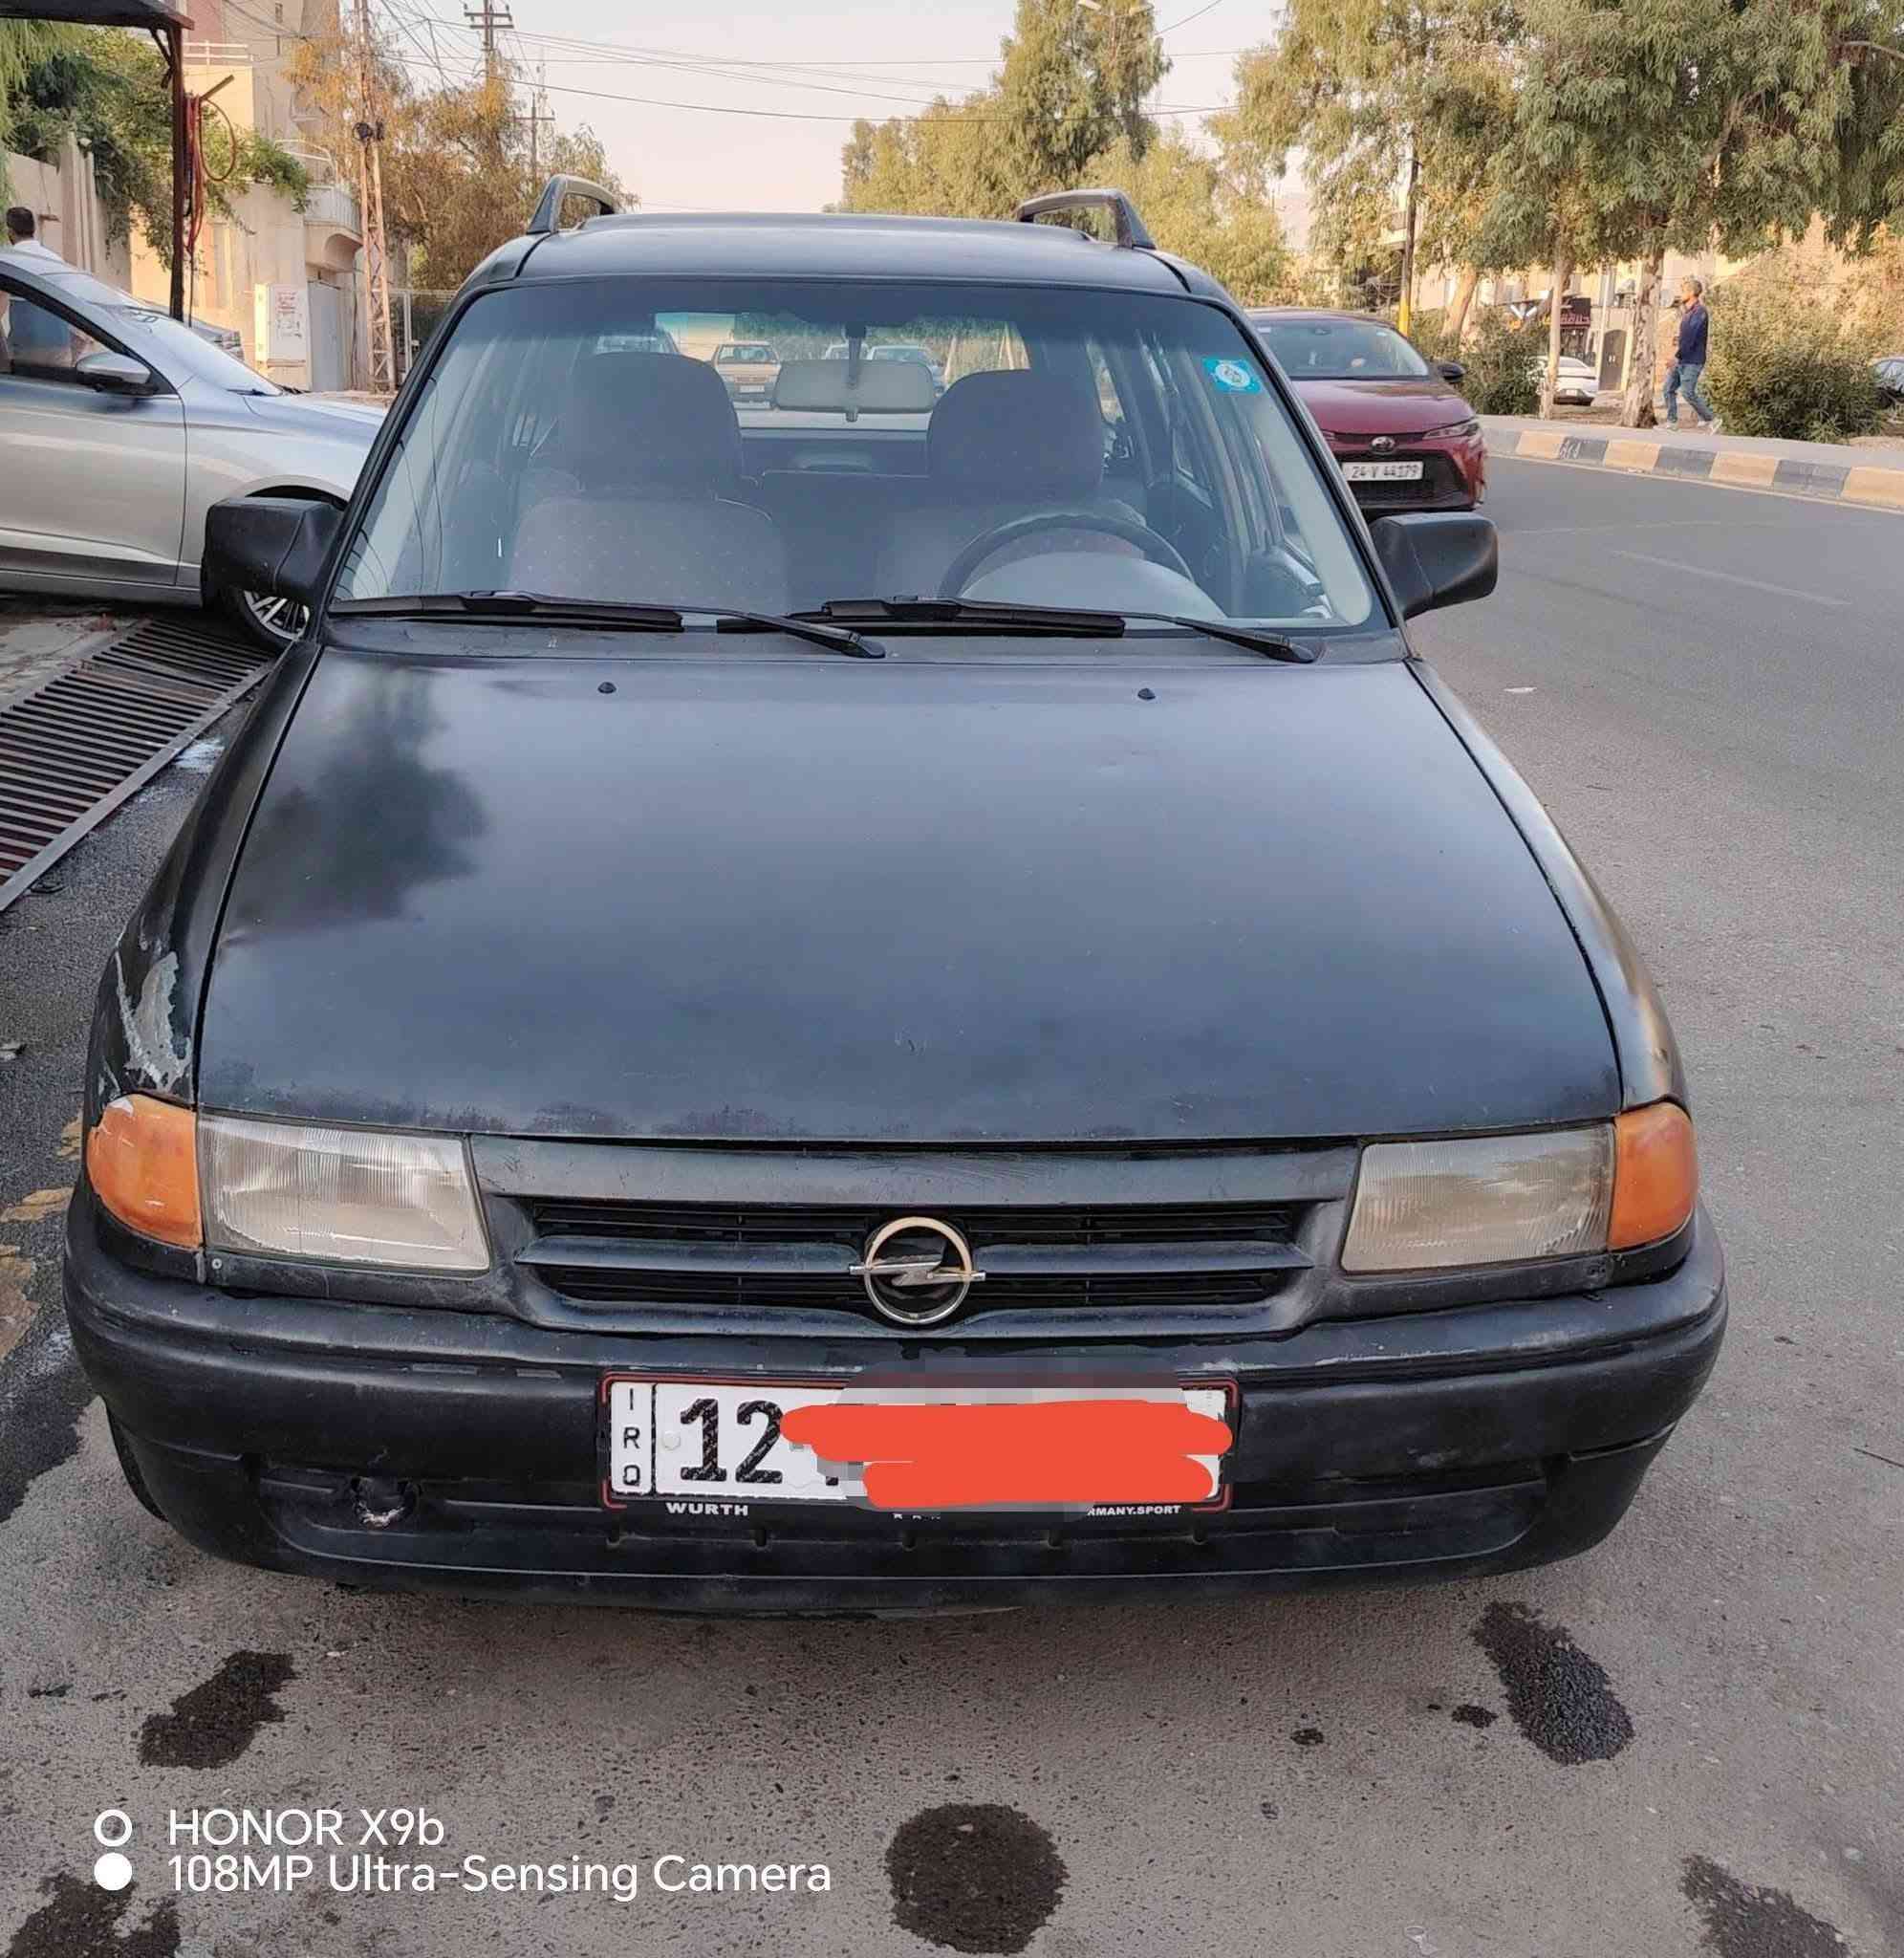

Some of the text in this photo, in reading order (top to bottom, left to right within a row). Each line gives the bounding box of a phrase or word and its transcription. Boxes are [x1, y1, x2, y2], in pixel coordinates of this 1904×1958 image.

[622, 1388, 641, 1487] IRQ
[666, 1502, 749, 1516] WURTH
[1088, 1504, 1181, 1517] RMANY.SPORT
